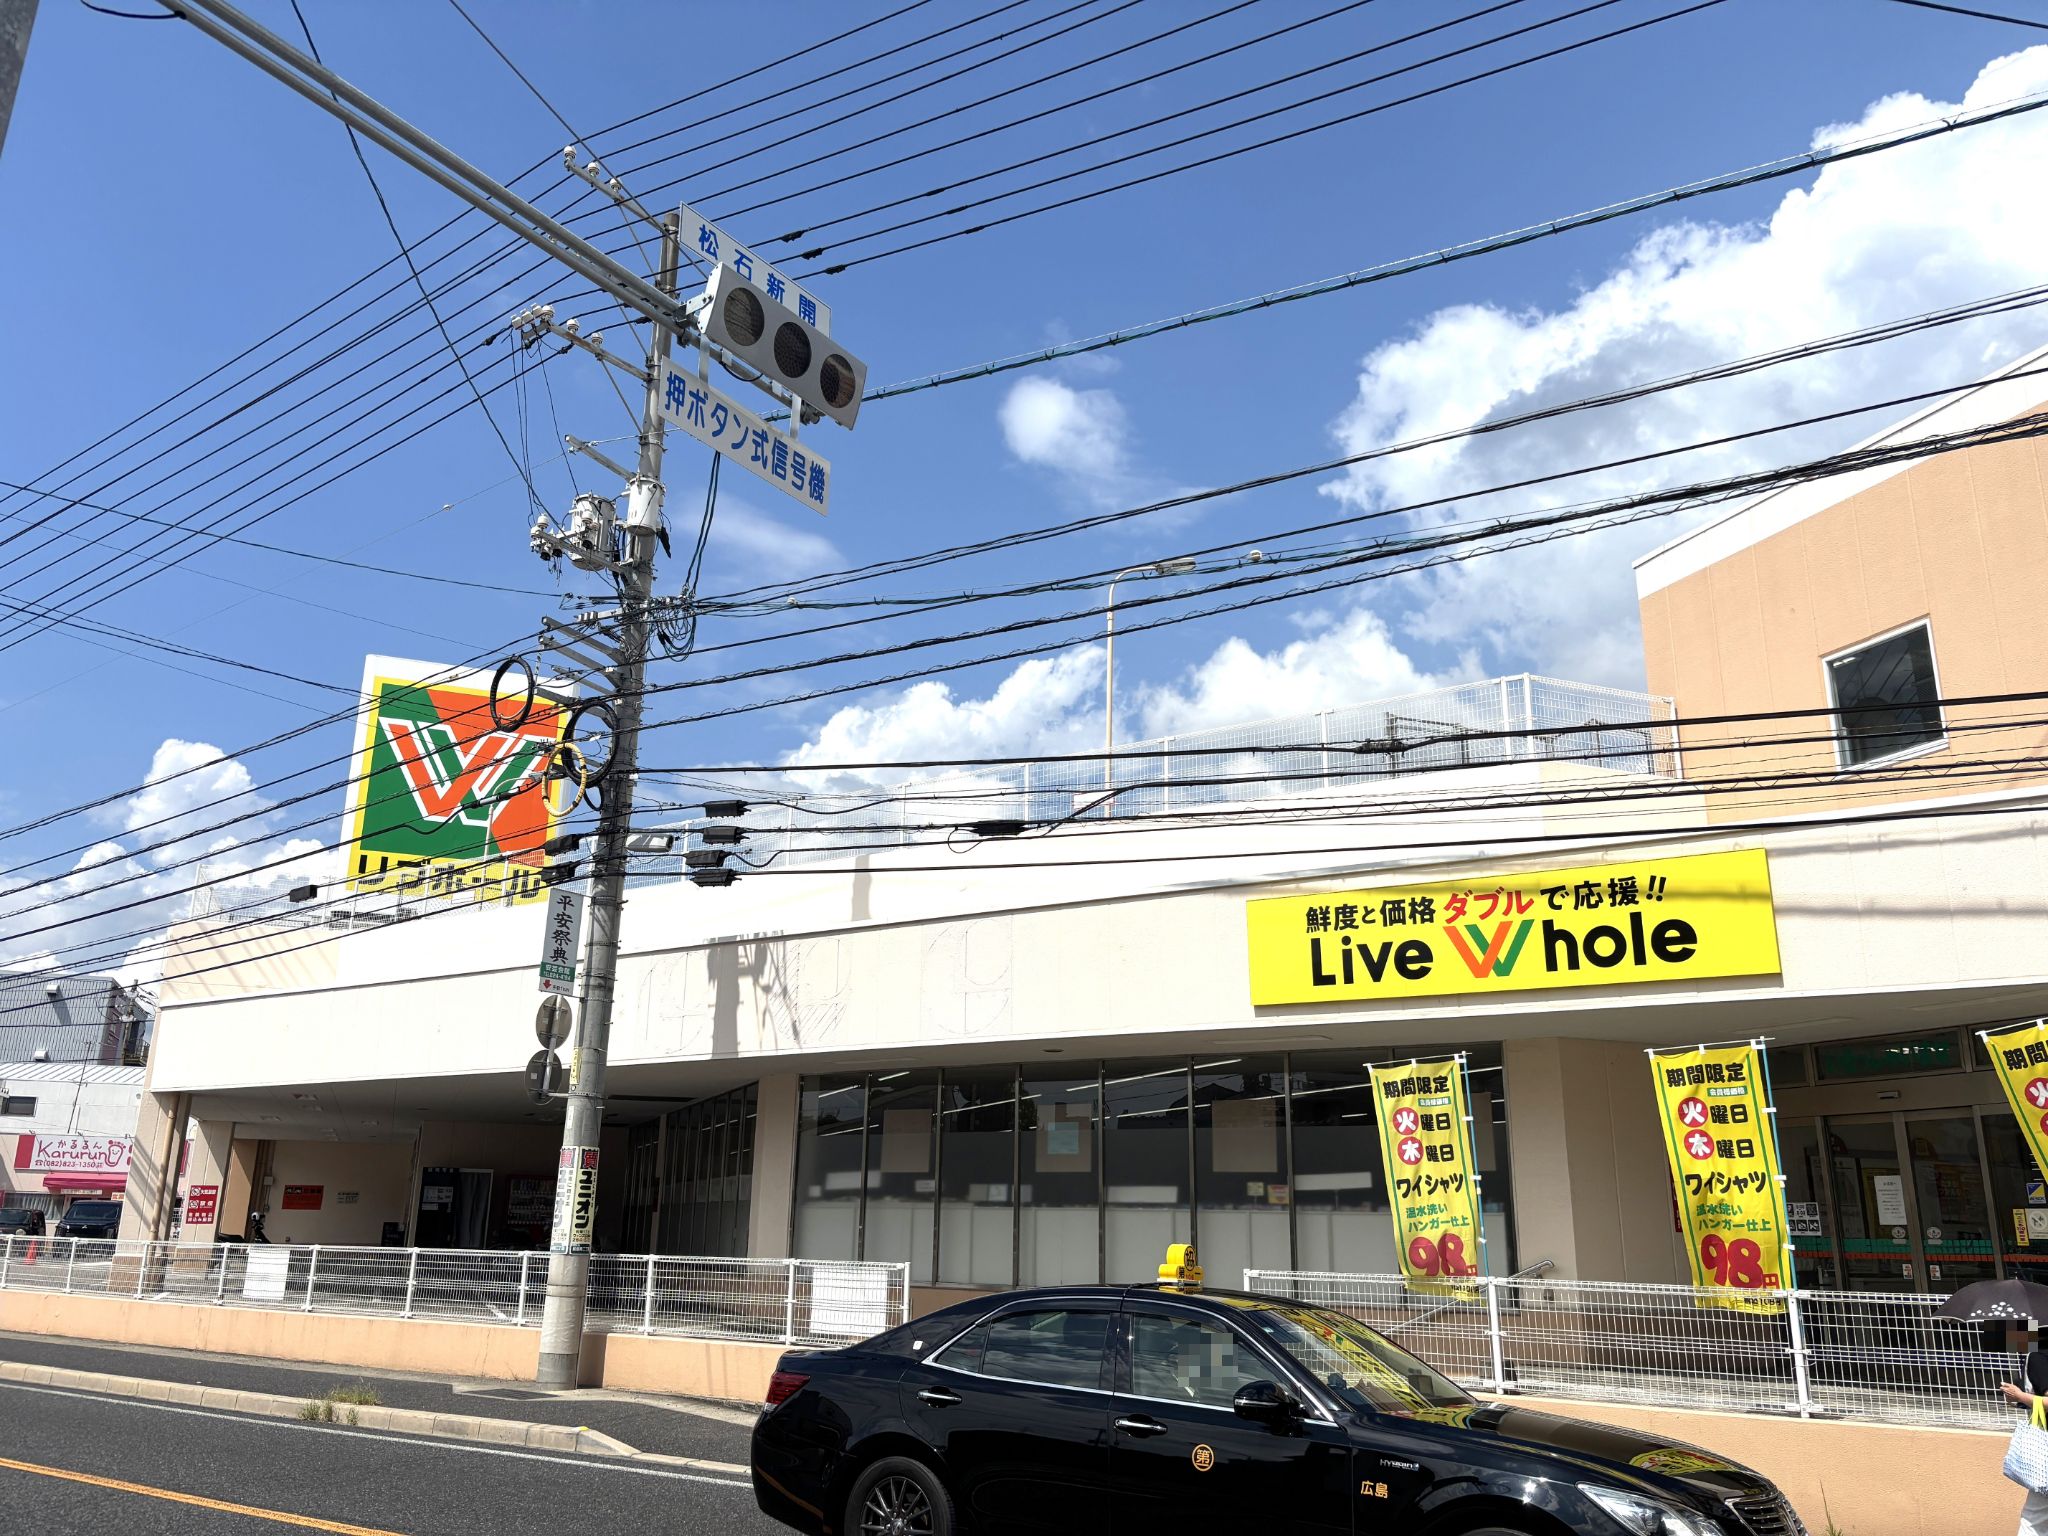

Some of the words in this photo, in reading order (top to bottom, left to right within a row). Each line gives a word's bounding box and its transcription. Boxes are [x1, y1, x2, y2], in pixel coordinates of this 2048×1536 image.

[698, 224, 816, 328] 松石新開
[664, 370, 827, 505] 押ボタン式信号機
[550, 894, 574, 965] 平安祭典
[1310, 935, 1434, 986] Live
[2003, 1040, 2048, 1071] 期間
[1383, 1075, 1450, 1098] 期間限定
[1666, 1063, 1746, 1087] 期間限定
[37, 1140, 107, 1160] Karurun
[57, 1140, 102, 1149] かるるん
[1396, 1172, 1464, 1199] ワイシャツ
[1685, 1171, 1767, 1196] ワイシャツ
[575, 1170, 593, 1229] ユニオン
[1406, 1203, 1448, 1218] 温水洗い
[1696, 1203, 1743, 1217] 温水洗い
[1408, 1215, 1470, 1233] ハンガー仕上
[1699, 1218, 1772, 1232] ハンガー仕上
[1361, 1480, 1388, 1499] 広島
